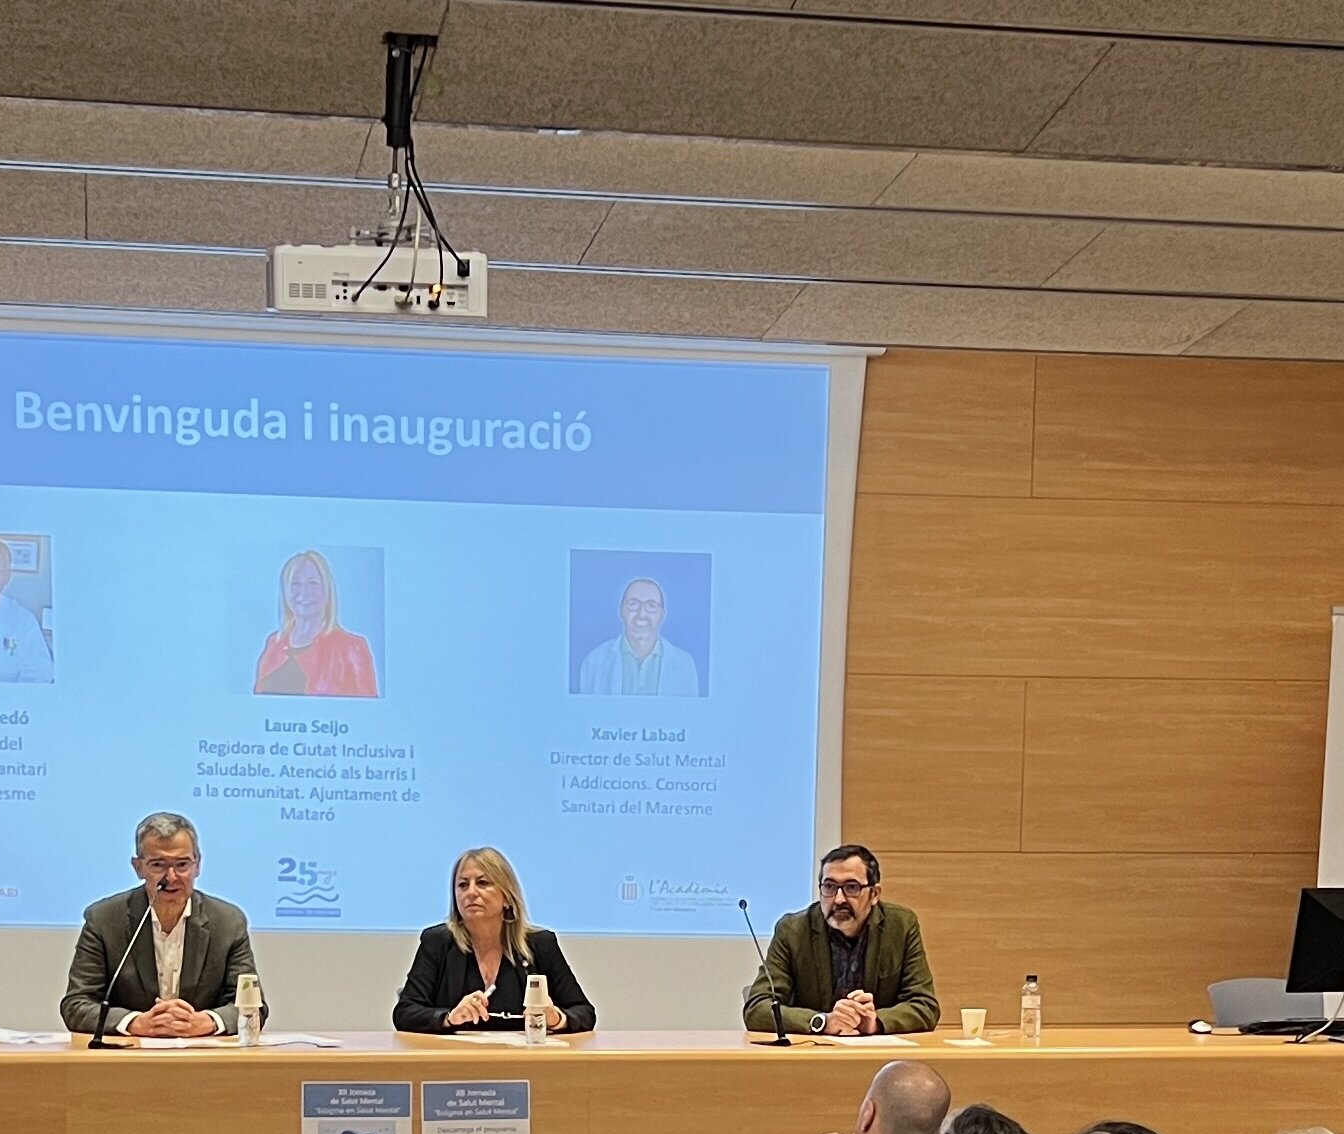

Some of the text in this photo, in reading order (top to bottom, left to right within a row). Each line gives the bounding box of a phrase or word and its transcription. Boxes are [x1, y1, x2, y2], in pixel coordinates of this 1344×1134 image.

[15, 391, 592, 456] Benvinguda i inauguració
[264, 718, 349, 737] Laura Seijo
[591, 727, 686, 743] Xavier Labad
[198, 739, 265, 757] Regidora
[269, 741, 289, 755] de
[293, 742, 337, 757] Ciutat
[342, 743, 406, 759] Inclusiva
[550, 751, 726, 769] Director de Salut Mental
[197, 761, 276, 778] Saludable.
[279, 764, 337, 780] Atenció
[341, 766, 361, 780] als
[365, 766, 407, 782] barris
[569, 776, 653, 791] Addiccions.
[655, 778, 718, 792] Consorci
[193, 784, 421, 803] a la comunitat. Ajuntament de
[280, 807, 336, 822] Mataró
[561, 800, 714, 816] Sanitari del Maresme
[357, 1106, 374, 1114] Salut
[458, 1099, 477, 1107] Salut
[479, 1098, 505, 1106] Mental
